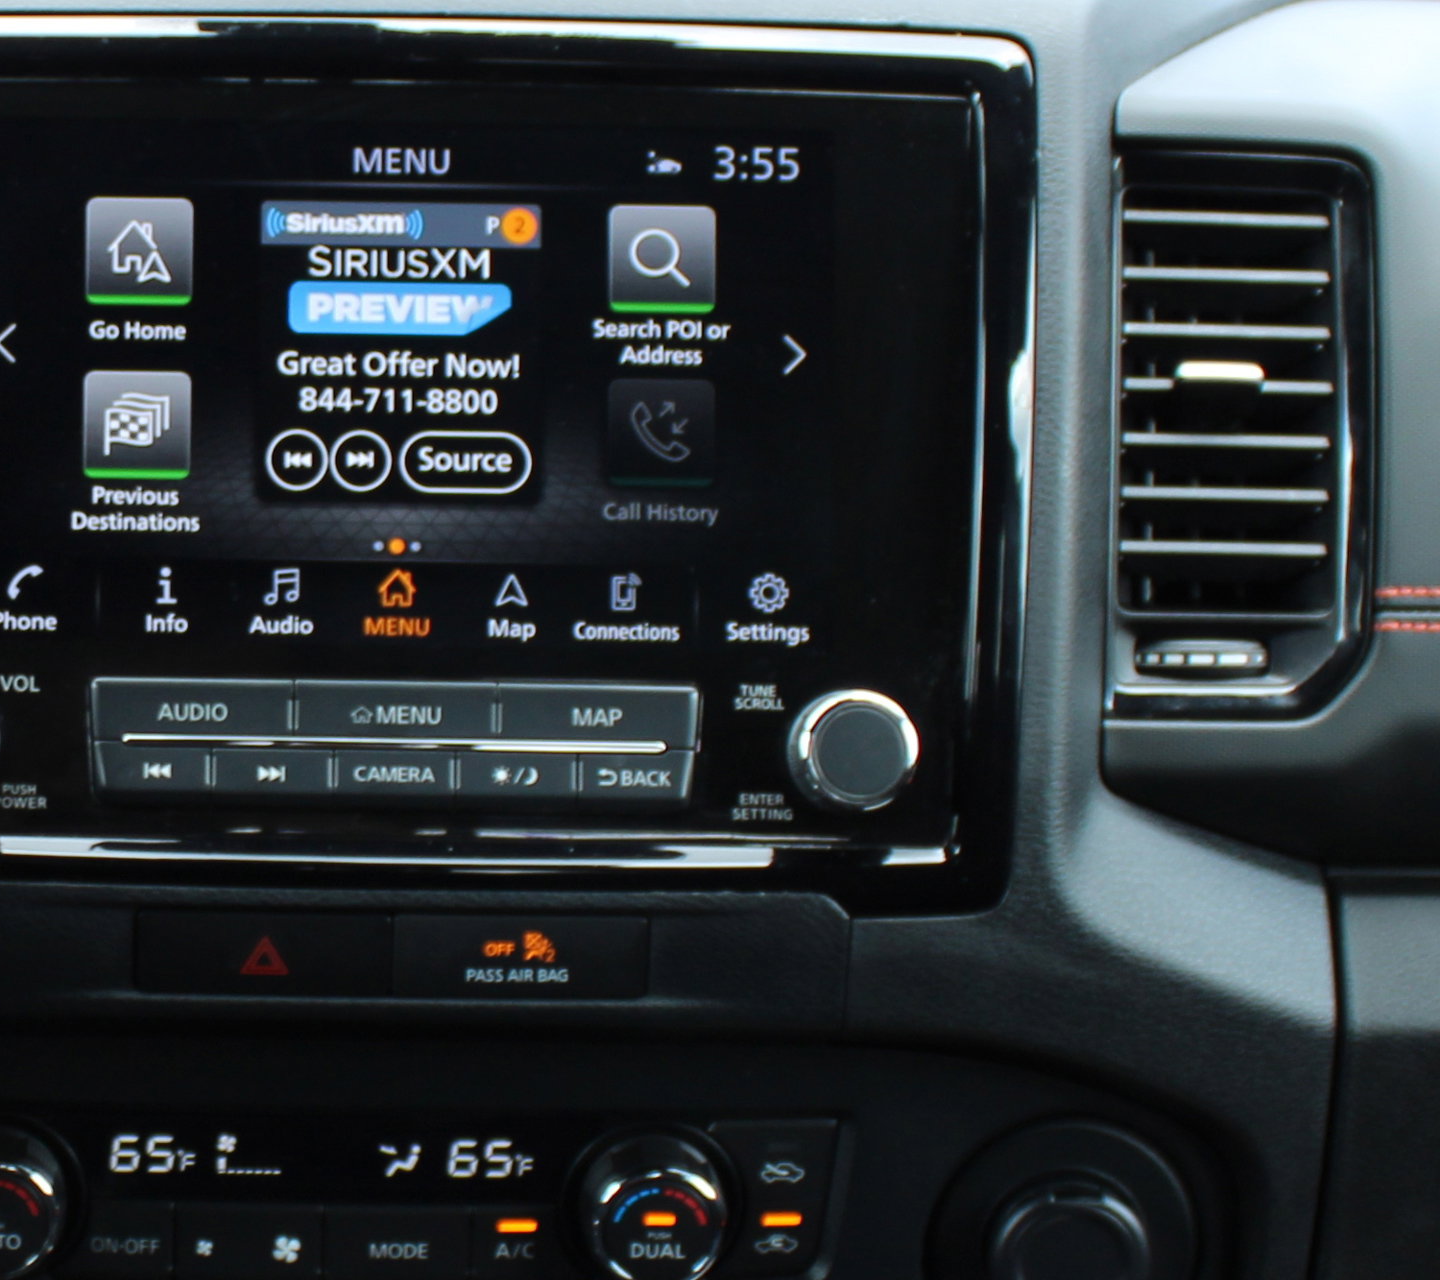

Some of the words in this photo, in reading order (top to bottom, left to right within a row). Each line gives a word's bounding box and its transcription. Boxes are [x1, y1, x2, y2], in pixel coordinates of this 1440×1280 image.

[353, 147, 451, 174] MENU
[713, 146, 801, 181] 3:55
[308, 245, 491, 280] SIRIUSXM
[307, 292, 494, 324] PREVIEW
[89, 320, 120, 341] Go
[124, 321, 187, 341] Home
[592, 318, 661, 340] Search
[665, 320, 703, 340] POI
[706, 324, 731, 340] or
[277, 350, 357, 377] Great
[362, 351, 439, 378] Offer
[444, 352, 521, 380] Now!
[619, 345, 704, 366] Address
[298, 386, 499, 415] 844-711-8800
[417, 445, 513, 473] Source
[91, 486, 180, 506] Previous
[71, 512, 201, 532] Destinations
[603, 503, 641, 521] Call
[646, 503, 719, 528] History
[145, 614, 189, 634] Info
[249, 615, 314, 636] Audio
[363, 617, 432, 637] MENU
[487, 619, 537, 644] Map
[573, 621, 680, 642] Connections
[726, 622, 810, 646] Settings
[0, 675, 41, 693] VOL
[740, 684, 777, 697] TUNE
[157, 703, 229, 722] AUDIO
[733, 696, 785, 711] SCROLL
[375, 705, 443, 725] MENU
[571, 707, 623, 727] MAP
[353, 766, 436, 784] CAMERA
[620, 769, 672, 788] BACK
[1, 784, 37, 796] PUSH
[738, 793, 784, 806] ENTER
[732, 808, 793, 822] SETTING
[483, 941, 516, 958] OFF
[465, 968, 504, 982] PASS
[507, 968, 534, 982] AIR
[537, 969, 569, 983] BAG
[369, 1243, 430, 1260] MODE
[495, 1243, 535, 1259] A/C
[630, 1243, 687, 1260] DUAL
